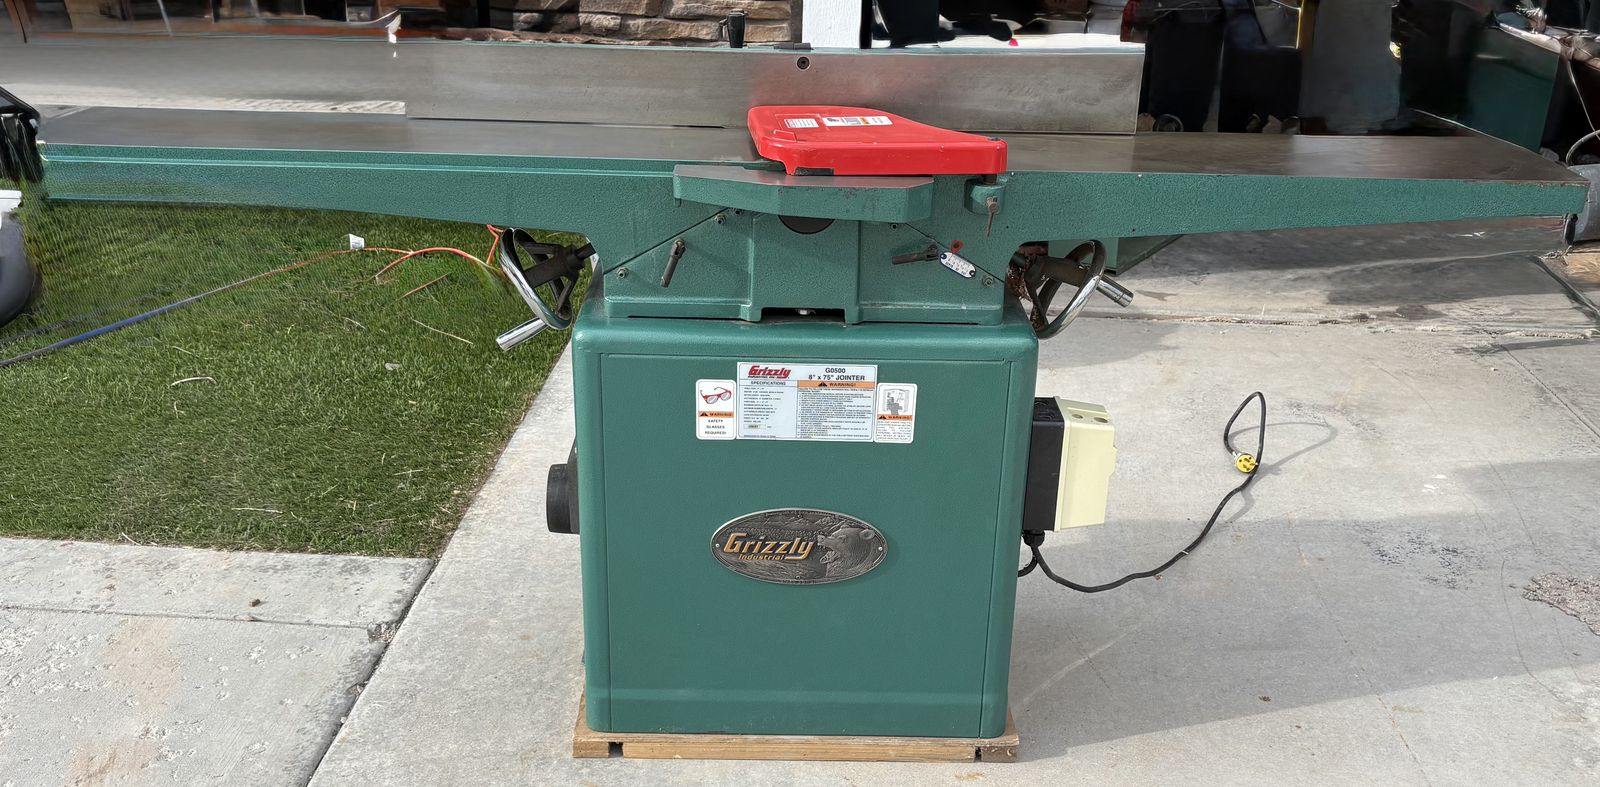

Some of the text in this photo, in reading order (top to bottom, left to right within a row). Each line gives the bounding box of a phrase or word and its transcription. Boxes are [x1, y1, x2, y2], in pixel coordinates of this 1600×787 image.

[748, 365, 791, 379] Grizzly
[723, 532, 814, 561] Grizzly
[738, 553, 785, 561] Industrial
